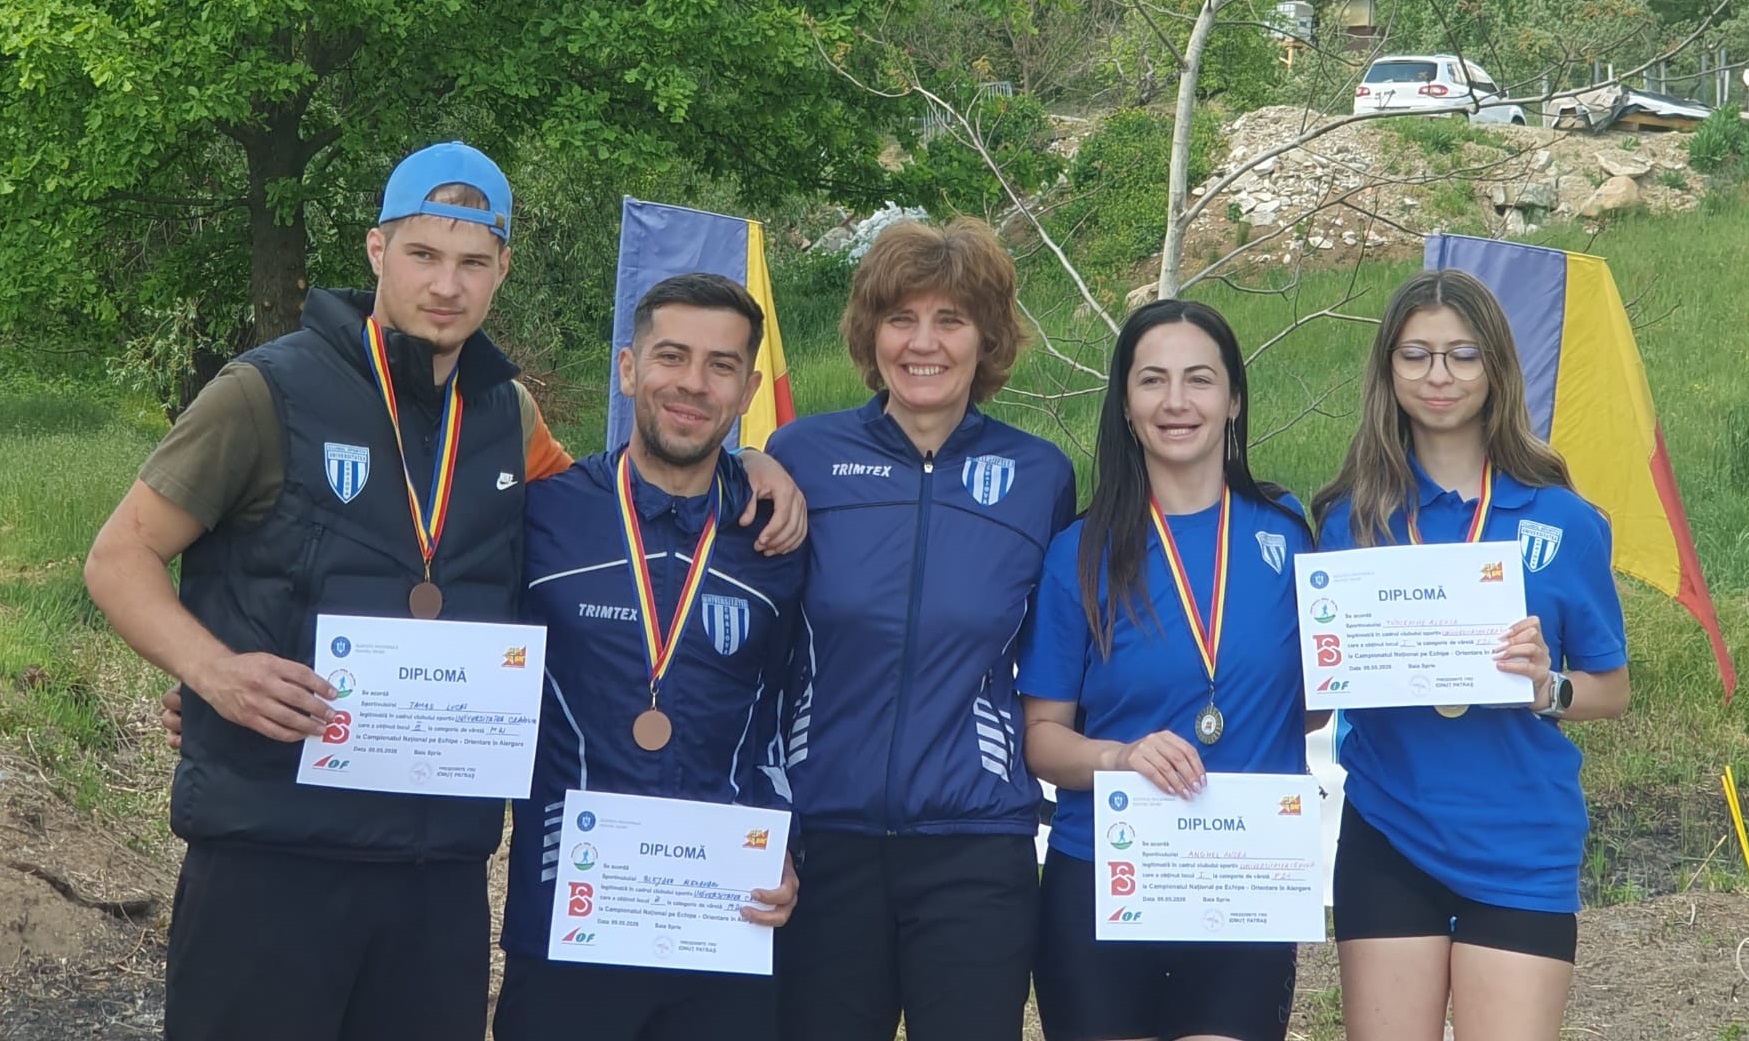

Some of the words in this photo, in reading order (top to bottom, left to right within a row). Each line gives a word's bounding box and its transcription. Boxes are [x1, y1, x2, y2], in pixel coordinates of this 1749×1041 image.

[832, 463, 893, 477] TRIMTEX
[1378, 586, 1447, 602] DIPLOMĂ
[578, 603, 638, 622] TRIMTEX
[398, 666, 467, 683] DIPLOMĂ
[1177, 816, 1247, 831] DIPLOMĂ
[639, 842, 707, 860] DIPLOMĂ
